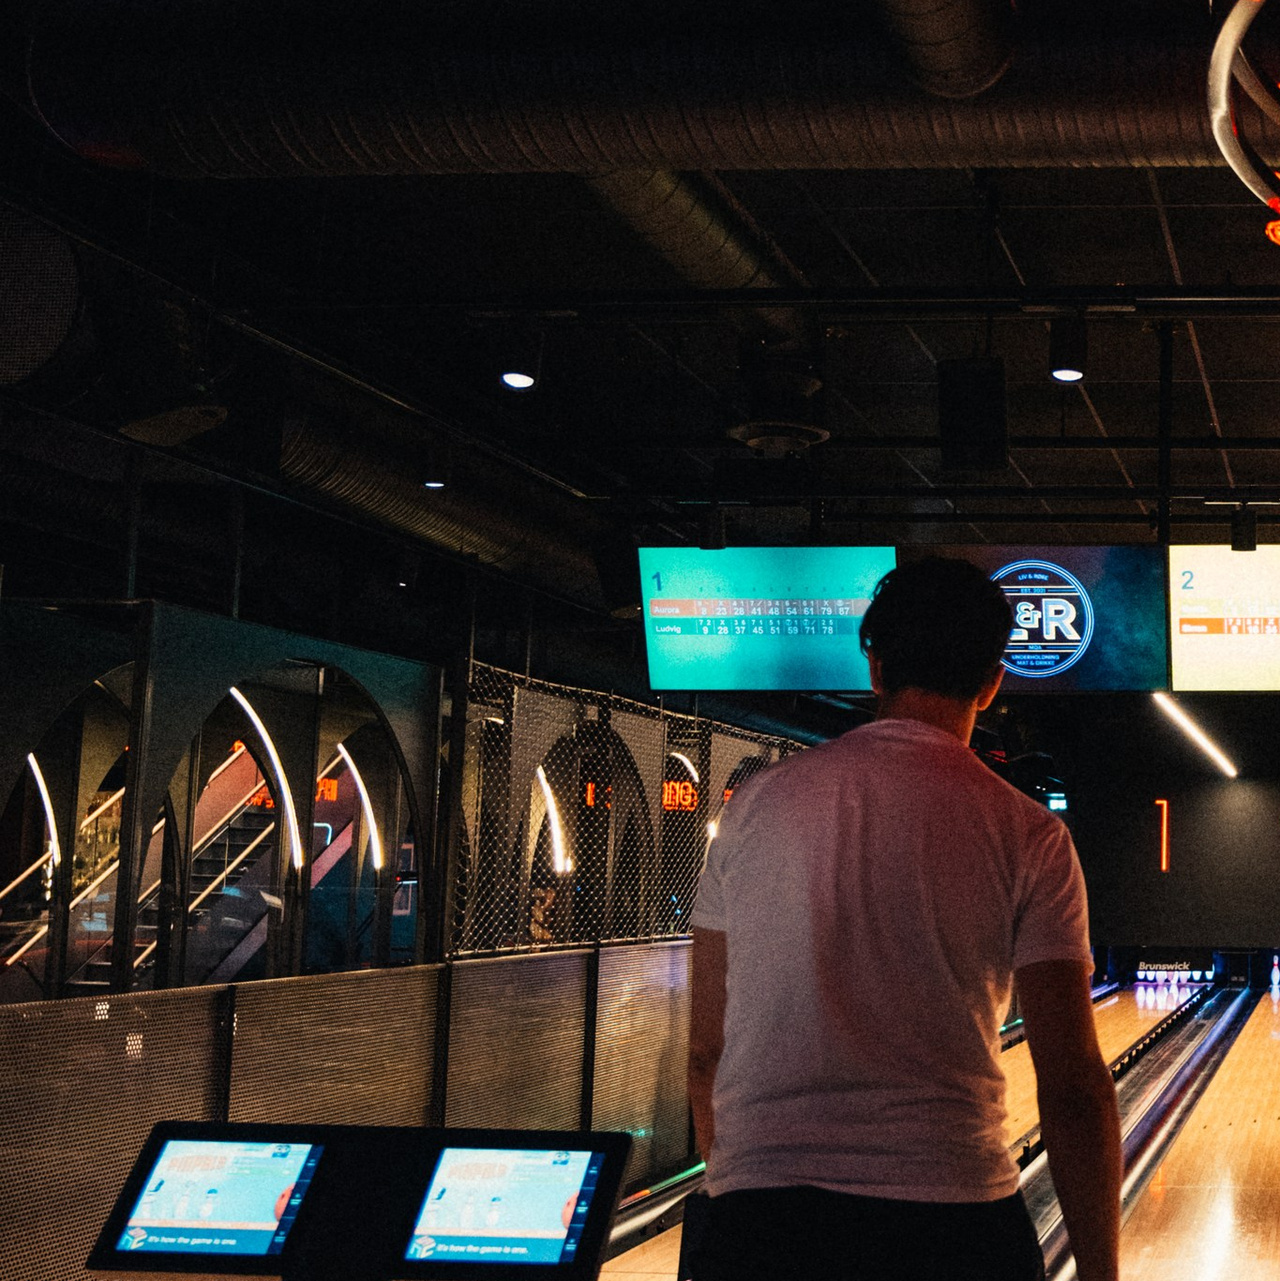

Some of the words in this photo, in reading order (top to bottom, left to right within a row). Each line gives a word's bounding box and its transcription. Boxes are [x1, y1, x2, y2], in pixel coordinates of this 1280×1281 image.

[652, 571, 662, 591] 1
[1182, 571, 1194, 590] 2
[654, 606, 680, 614] Aurora
[656, 625, 681, 634] Ludvig
[1155, 798, 1170, 872] 1
[1138, 961, 1192, 971] Brunswick
[449, 1244, 466, 1252] how
[479, 1246, 503, 1254] game
